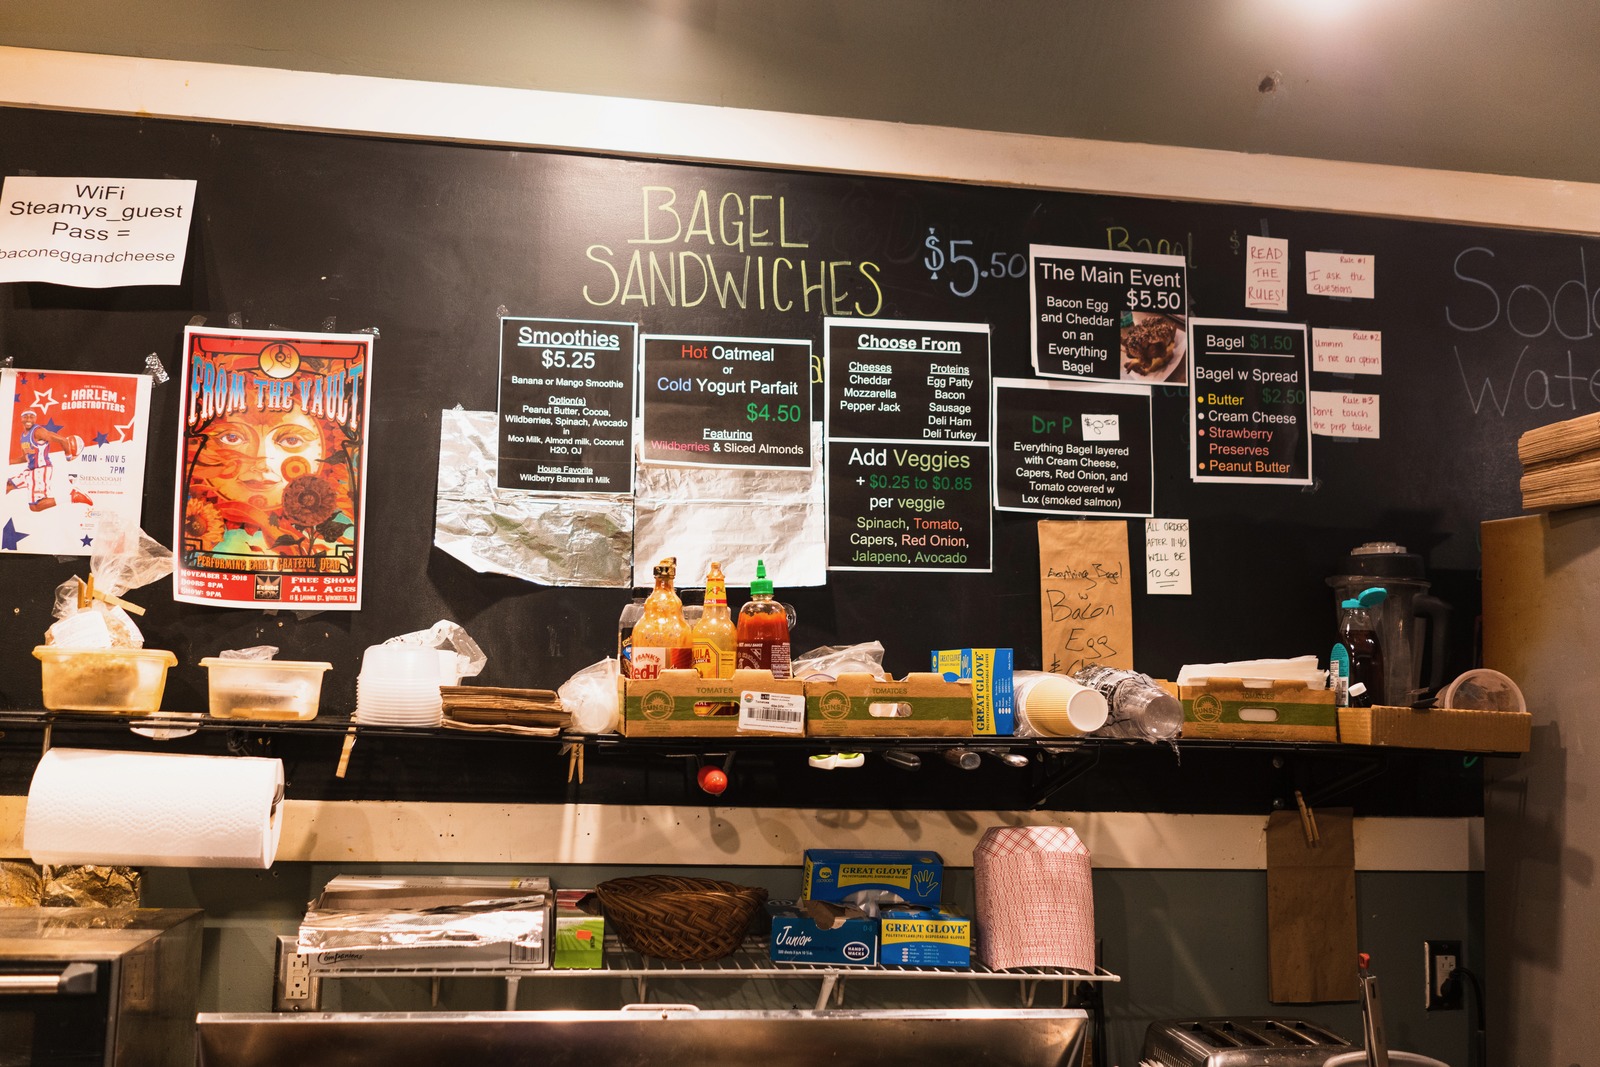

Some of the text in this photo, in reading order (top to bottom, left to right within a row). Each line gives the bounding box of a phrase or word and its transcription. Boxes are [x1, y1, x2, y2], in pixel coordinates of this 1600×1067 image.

[76, 184, 125, 200] WiFi
[10, 201, 183, 221] Steamys_guest
[628, 186, 808, 252] BAGEL
[52, 222, 109, 240] Pass
[1250, 246, 1283, 259] READ
[924, 228, 1027, 297] $5.50
[1040, 263, 1181, 288] The Main Event
[1253, 267, 1278, 279] THE
[583, 245, 882, 316] SANDWICHES
[1248, 287, 1284, 303] RULES!
[1314, 283, 1352, 293] questions
[1046, 296, 1109, 313] Bacon Egg
[1126, 288, 1181, 310] $5.50
[1041, 313, 1114, 327] and Cheddar
[518, 326, 620, 349] Smoothies
[858, 334, 961, 353] Choose From
[1206, 334, 1292, 350] Bagel $1.50
[541, 349, 595, 369] $5.25
[682, 345, 774, 361] Hot Oatmeal
[1048, 343, 1107, 361] Everything
[849, 362, 892, 373] Cheeses
[930, 364, 970, 375] Proteins
[1062, 360, 1094, 374] Bagel
[511, 376, 624, 388] Banana Mango Smoothie
[849, 375, 891, 385] Cheddar
[1196, 366, 1298, 384] Bagel Spread
[657, 377, 799, 396] Cold Yogurt Parfait
[927, 376, 973, 389] Egg Patty
[71, 389, 118, 402] HARLEM
[188, 352, 363, 431] FROM THE VAULT
[844, 388, 896, 398] Mozzarella
[935, 390, 965, 400] Bacon
[1262, 387, 1305, 404] $2.50
[548, 395, 586, 406] Option(s)
[1208, 393, 1244, 405] Butter
[61, 401, 125, 413] GLOBETROTTERS
[522, 405, 611, 417] Peanut Butter, Cocoa,
[747, 402, 801, 423] $4.50
[840, 401, 900, 412] Pepper Jack
[929, 402, 971, 415] Sausage
[1313, 407, 1368, 418] Don't touch
[505, 415, 628, 427] Wildberries, Spinach, Avocado
[1208, 410, 1297, 424] Cream Cheese
[1032, 415, 1073, 434] Dr P
[1314, 421, 1325, 429] the
[1331, 423, 1346, 433] prep
[703, 428, 753, 440] Featuring
[923, 429, 977, 441] Deli Turkey
[1209, 427, 1273, 442] Strawberry
[651, 440, 804, 455] Wildberries Sliced Almonds
[1013, 442, 1129, 457] Everything Bagel layered
[1209, 443, 1269, 456] Preserves
[82, 454, 97, 463] MON
[105, 455, 119, 463] NOV
[848, 448, 971, 472] Add Veggies
[110, 466, 125, 474] 7PM
[1209, 460, 1290, 473] Peanut Butter
[1016, 468, 1128, 482] Capers, Red Onion, and
[869, 474, 972, 491] $0.25 to $0.85
[869, 496, 945, 512] per veggie
[1022, 494, 1121, 509] Lox (smoked salmon)
[857, 517, 963, 531] Spinach, Tomato,
[1147, 522, 1188, 533] ALL ORDERS
[850, 533, 969, 548] Capers, Red Onion,
[1147, 538, 1167, 547] AFTER
[197, 555, 340, 571] PERFORMING EARLY GRATEFUL DEAD
[852, 550, 967, 564] Jalapeno, Avocado
[1148, 552, 1186, 562] WILL BE
[181, 570, 221, 579] NOVEMBER
[1149, 568, 1180, 578] TO GO
[207, 581, 224, 589] 8PM
[206, 590, 222, 598] 9PM
[1046, 589, 1114, 622] Bacon
[1065, 628, 1117, 659] Egg
[636, 653, 661, 663] FRANK'S
[976, 694, 985, 731] GREAT
[885, 923, 924, 933] GREAT
[776, 926, 812, 946] Junior
